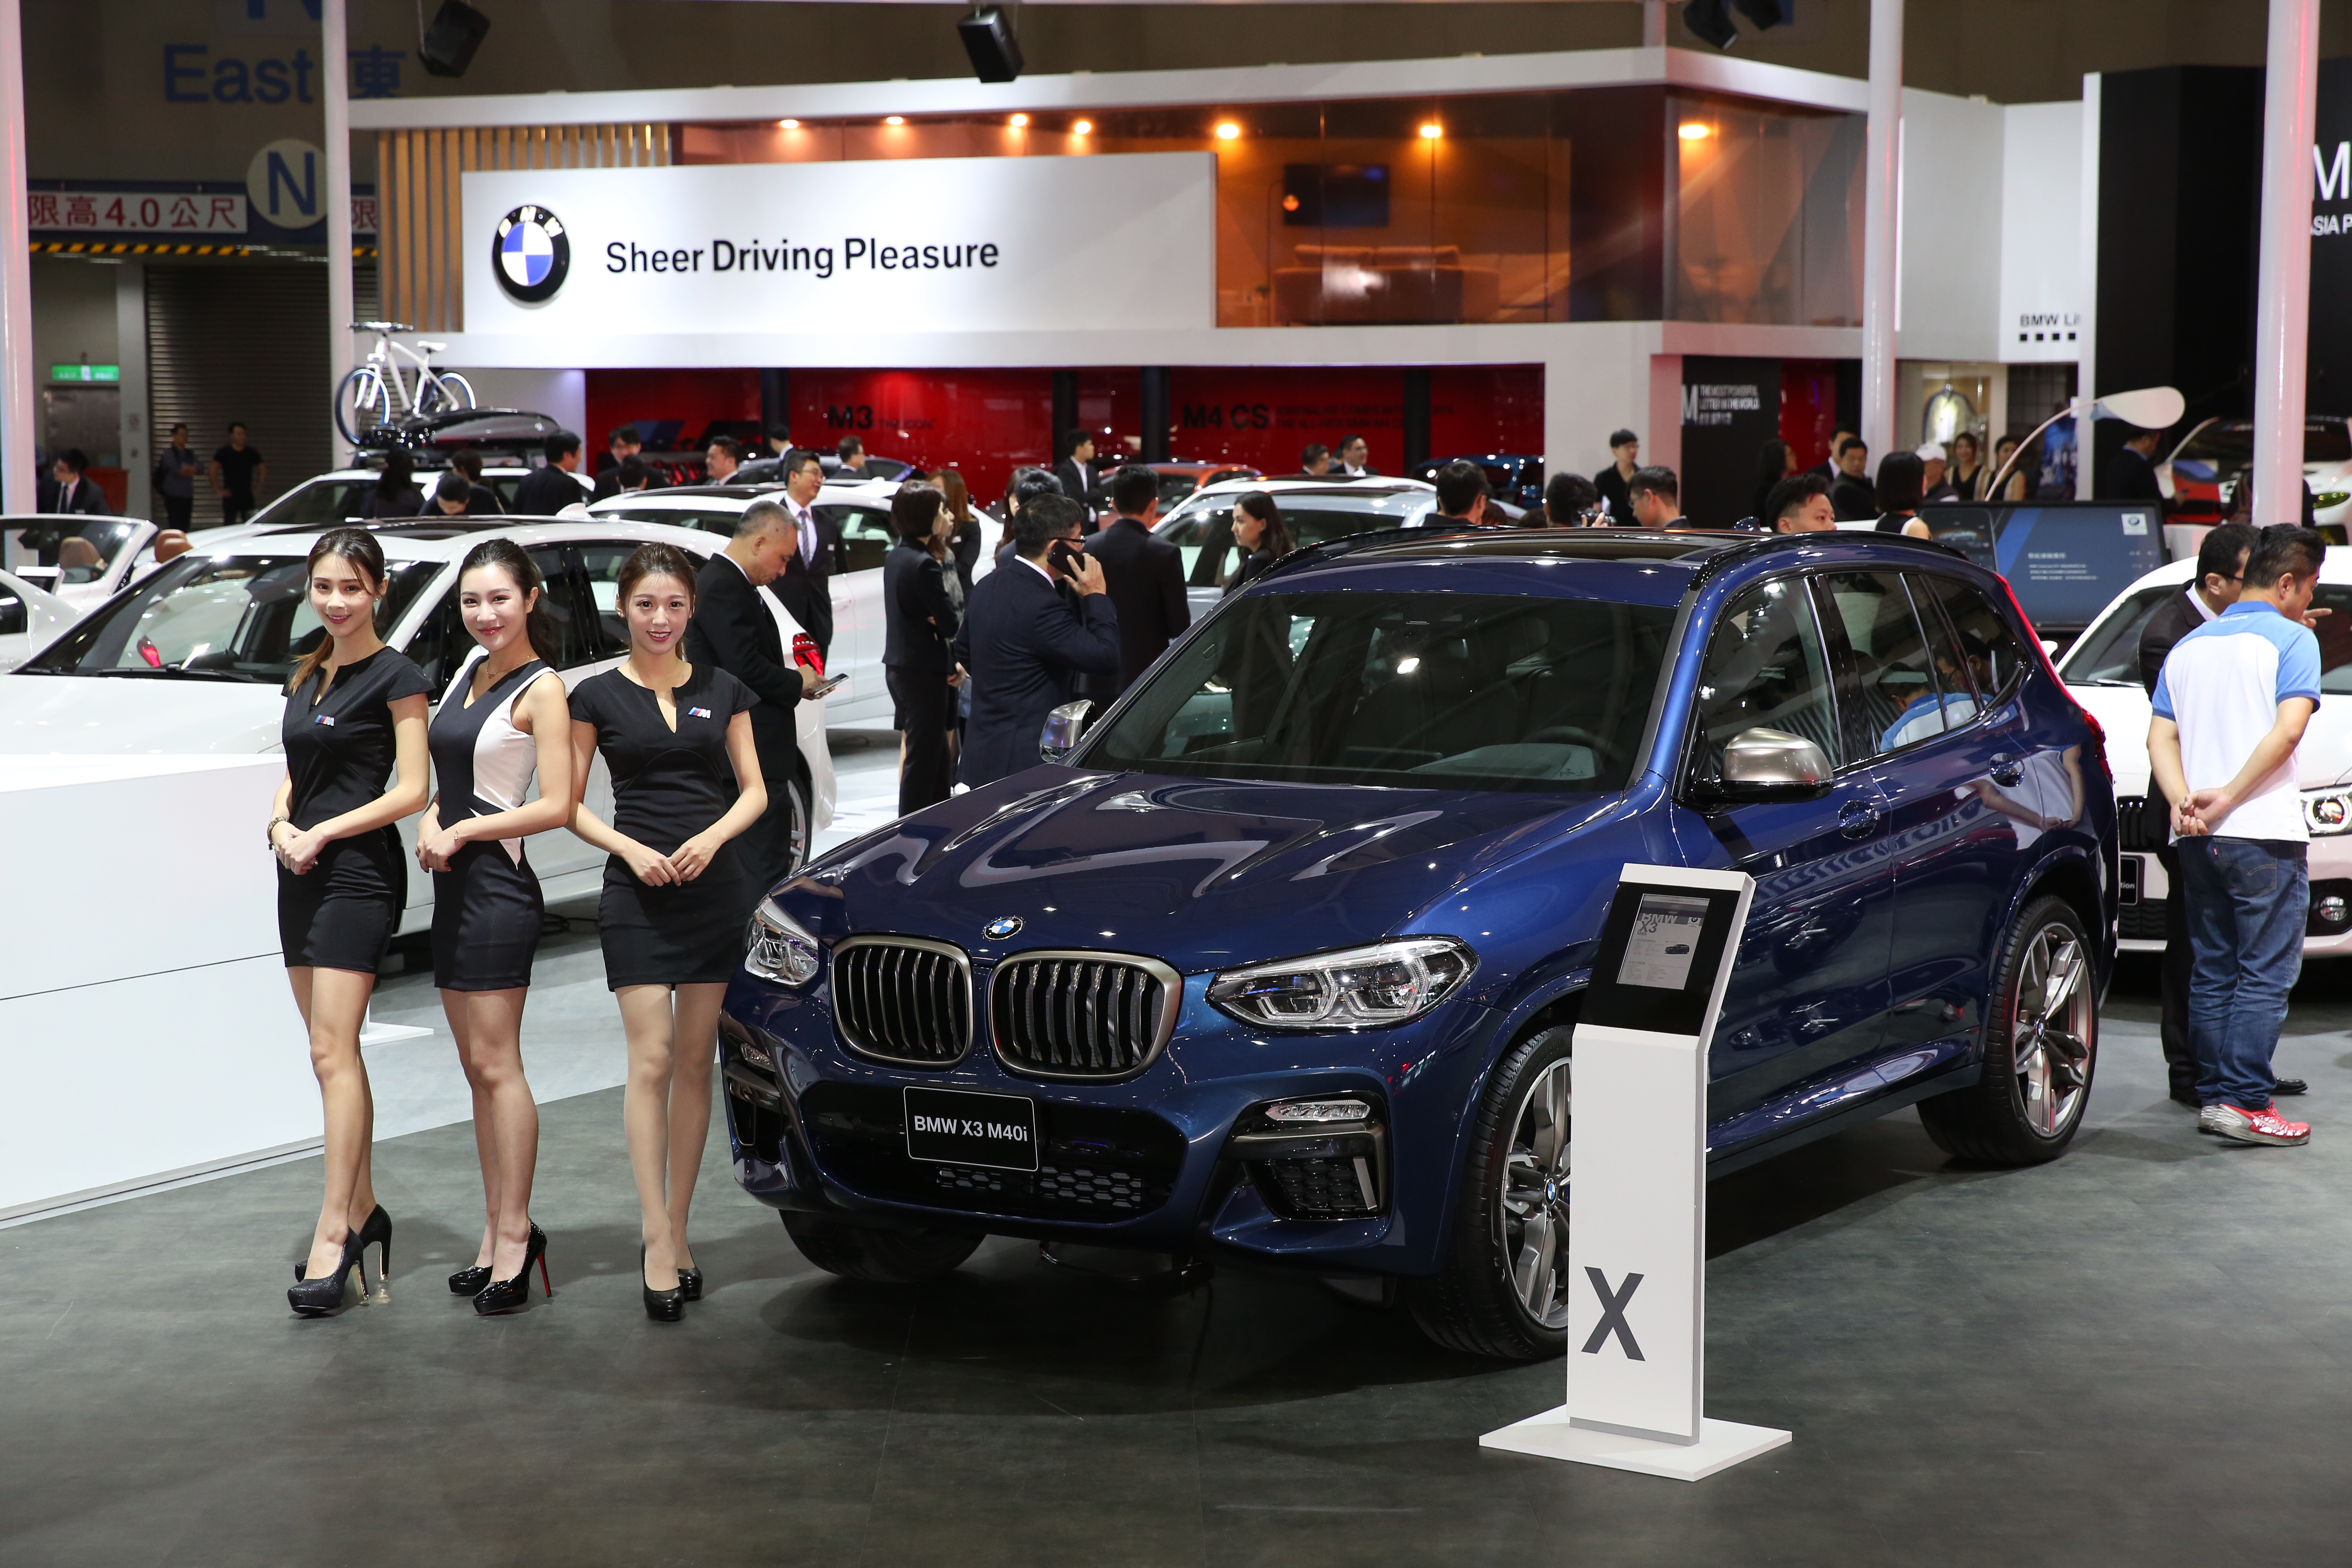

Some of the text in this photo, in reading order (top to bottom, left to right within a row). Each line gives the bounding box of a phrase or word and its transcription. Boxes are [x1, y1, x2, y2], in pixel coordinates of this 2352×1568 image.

[164, 44, 313, 104] East
[267, 151, 316, 216] N
[2313, 140, 2352, 201] M
[28, 195, 237, 229] 限高4.0公尺
[2310, 214, 2340, 236] SIA
[606, 237, 1000, 279] Sheer Driving Pleasure
[2020, 313, 2059, 327] BMW
[827, 405, 873, 429] M3
[1183, 403, 1270, 430] M4 CS
[1639, 921, 1658, 933] X3
[1642, 913, 1678, 924] BMW
[914, 1115, 1028, 1142] BMW X3 M40i
[1581, 1265, 1646, 1362] X
